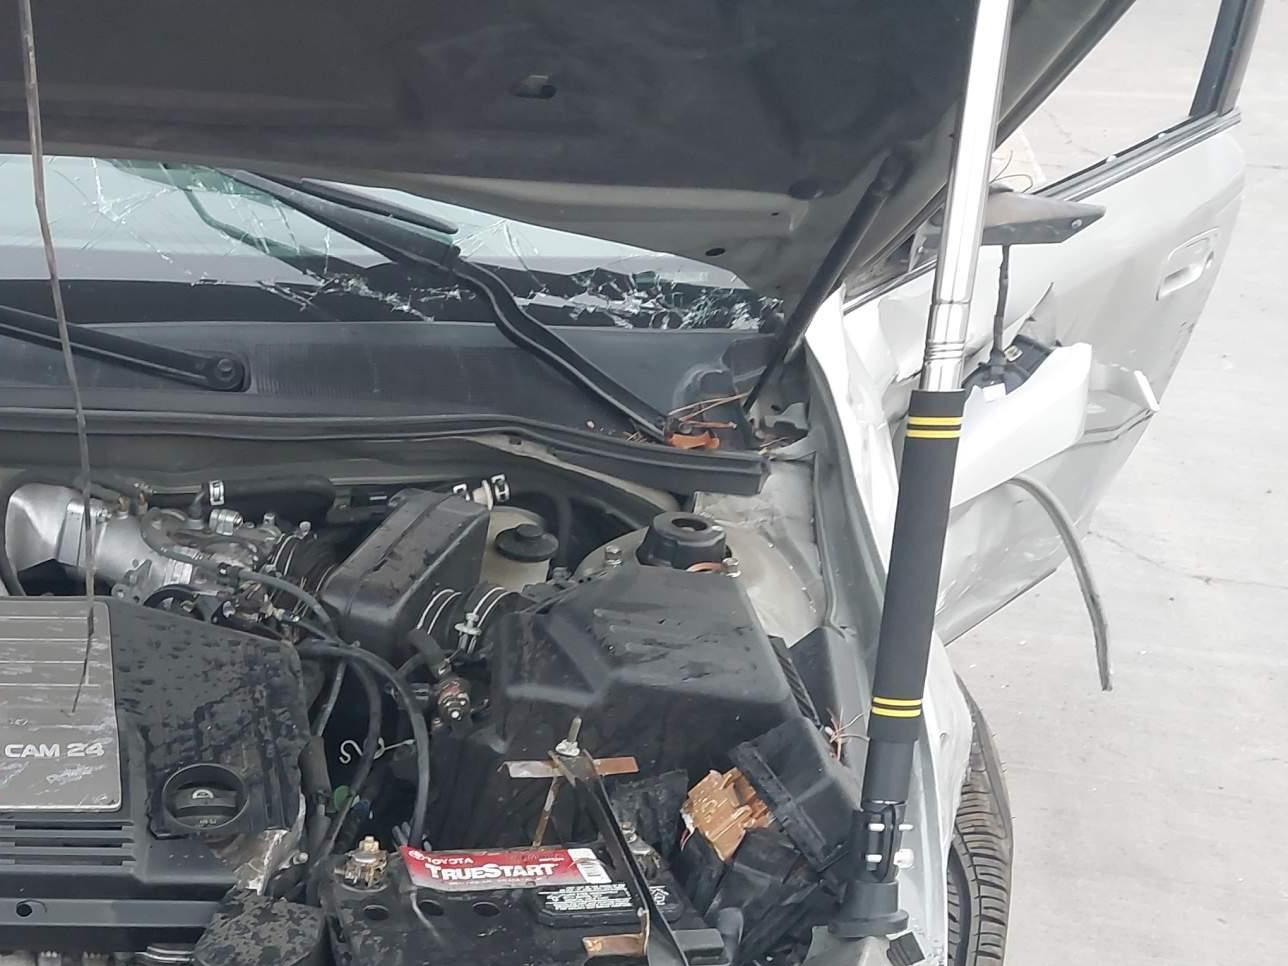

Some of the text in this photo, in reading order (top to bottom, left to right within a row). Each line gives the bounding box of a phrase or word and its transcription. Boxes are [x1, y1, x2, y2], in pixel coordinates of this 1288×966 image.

[4, 743, 60, 758] CAM
[67, 742, 105, 757] 24
[424, 856, 474, 865] TOYOTA
